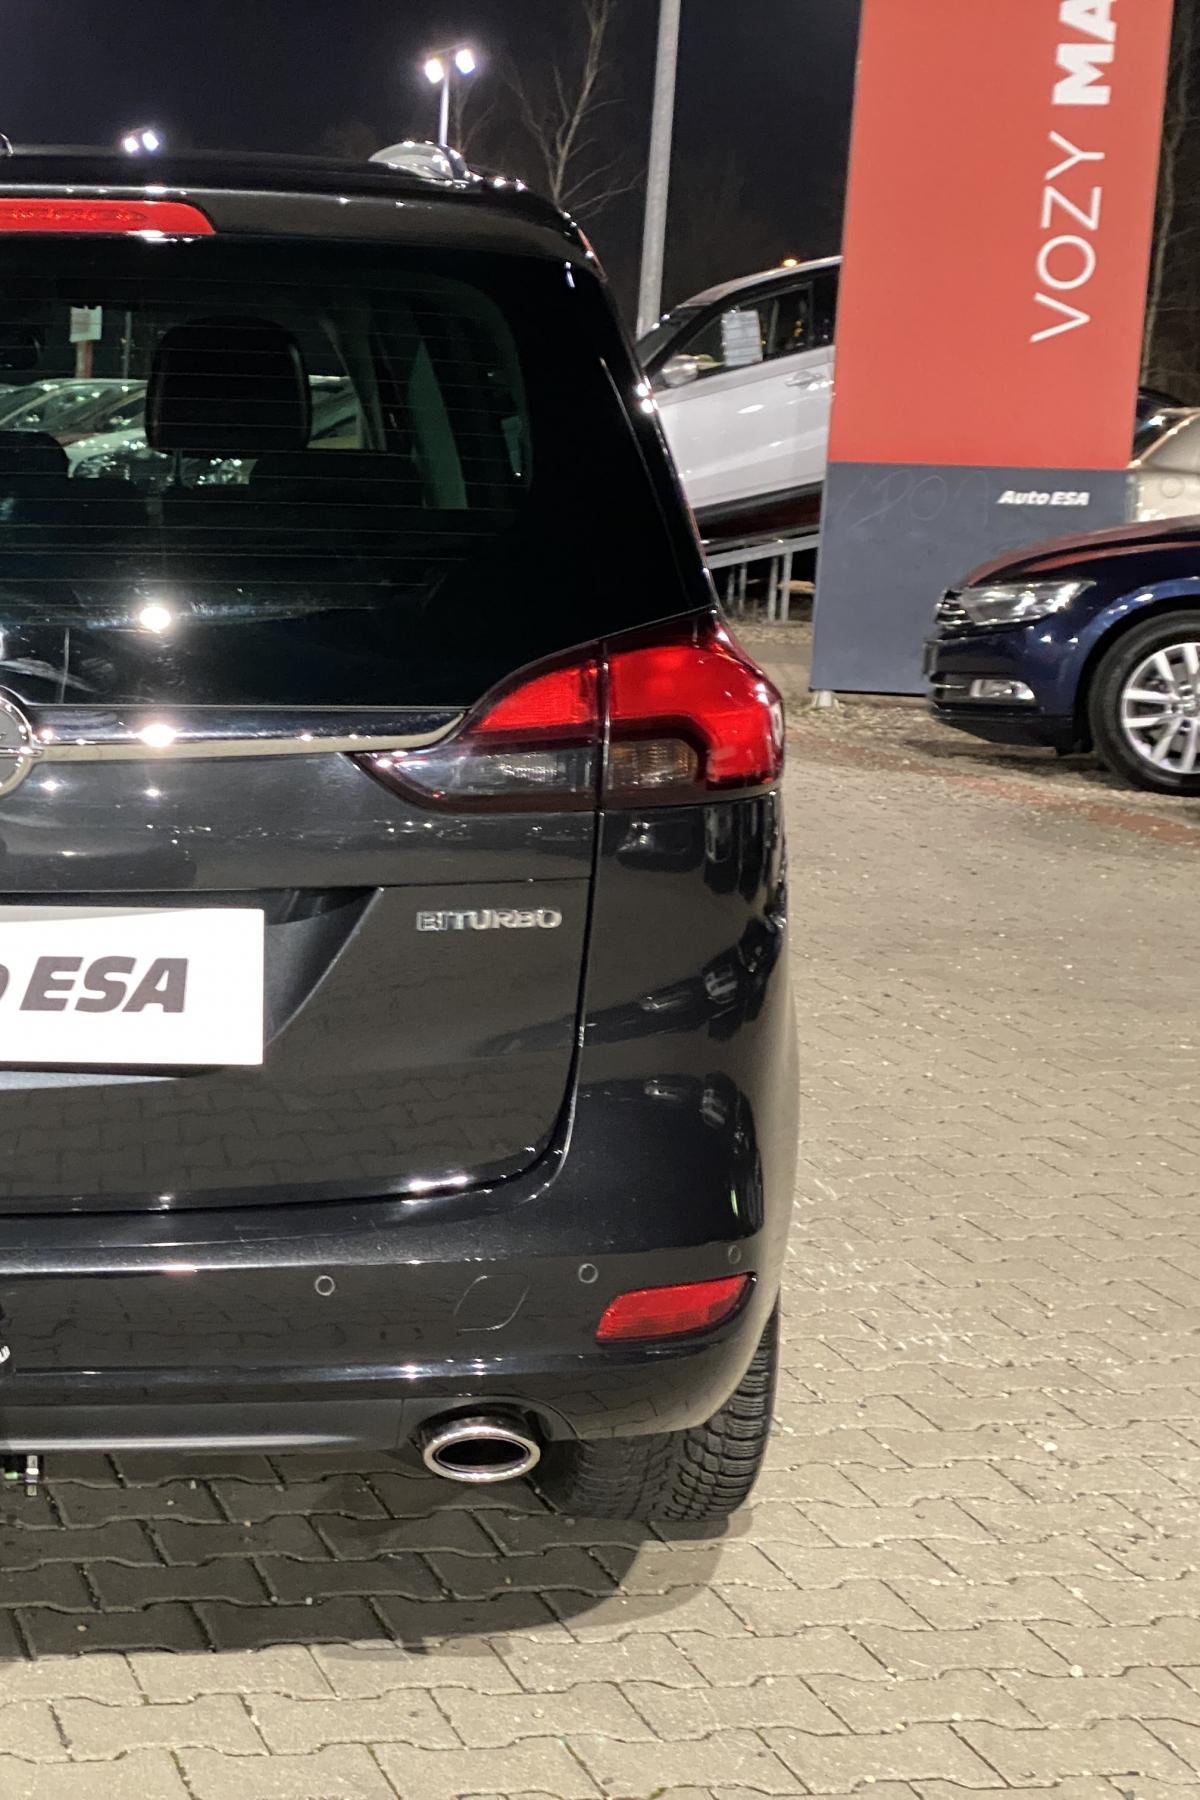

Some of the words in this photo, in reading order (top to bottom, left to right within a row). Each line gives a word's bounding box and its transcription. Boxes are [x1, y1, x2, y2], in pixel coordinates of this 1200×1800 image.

[1029, 130, 1105, 342] VOZY
[996, 490, 1050, 505] Auto
[1049, 491, 1090, 506] ESA
[415, 908, 563, 932] BITURBO
[19, 955, 189, 1014] ESA
